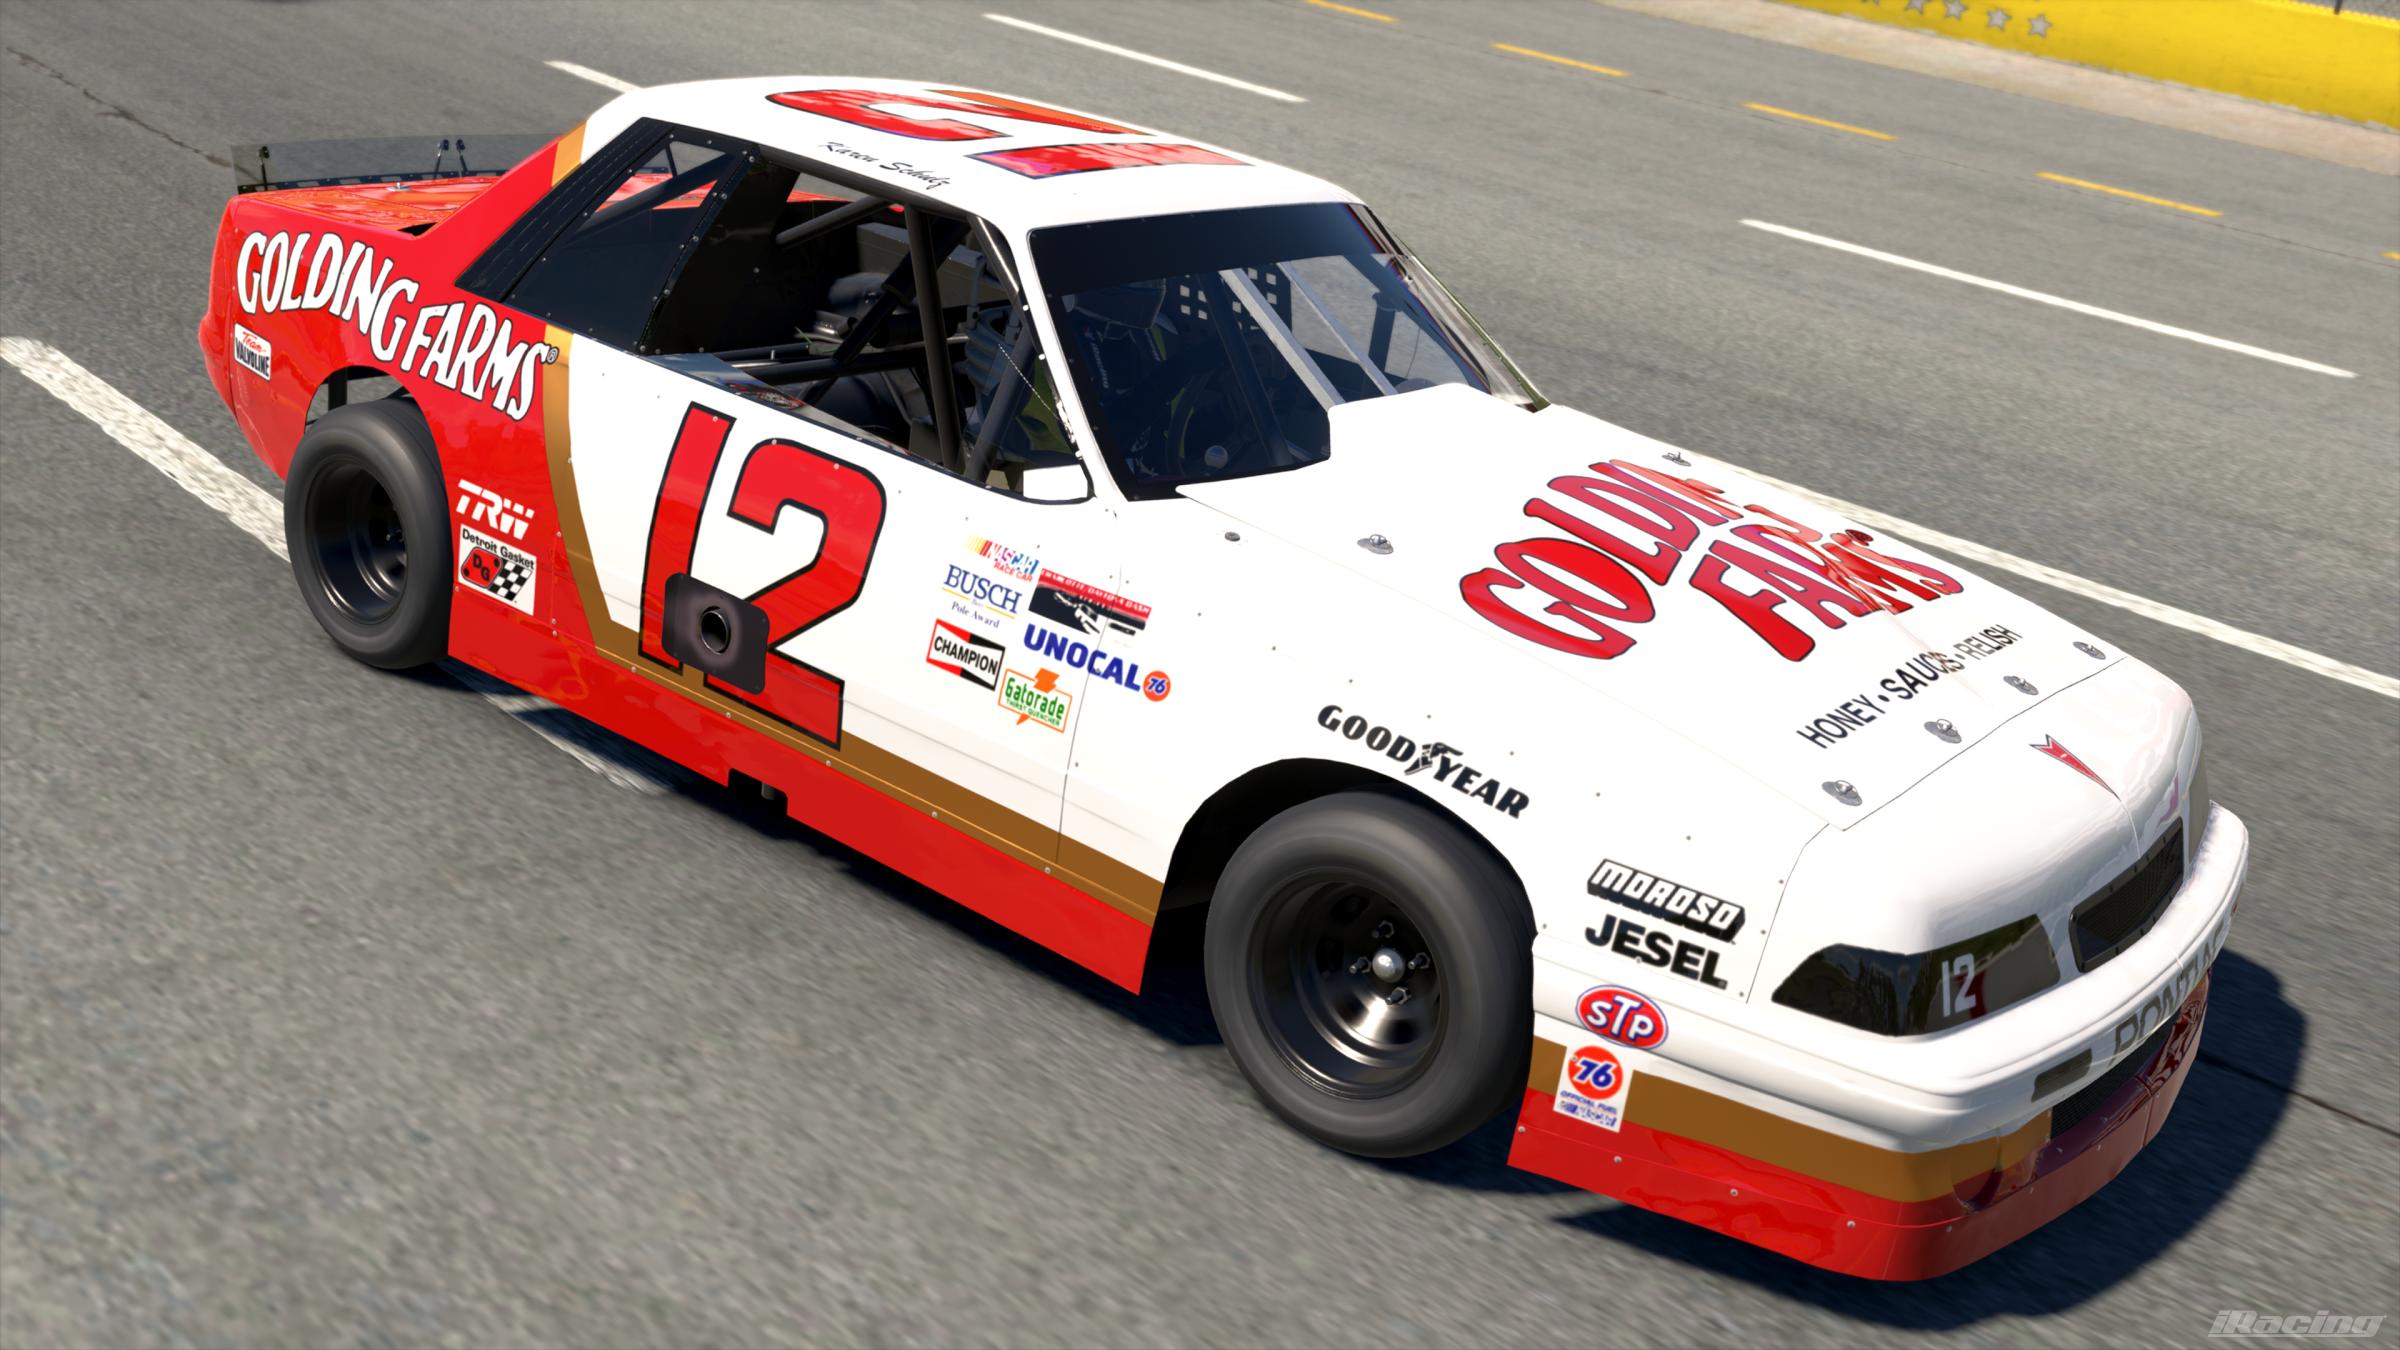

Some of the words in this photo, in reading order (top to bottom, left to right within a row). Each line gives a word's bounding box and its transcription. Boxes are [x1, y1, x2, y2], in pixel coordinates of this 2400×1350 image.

[819, 141, 878, 162] Karen
[879, 161, 950, 190] Schulz
[236, 230, 420, 361] GOLDING
[235, 336, 270, 378] VALVOLINE
[242, 331, 267, 353] Team
[456, 479, 535, 541] TRW
[462, 527, 498, 554] Detroit
[500, 545, 535, 570] Gasket
[993, 562, 1014, 577] RACE
[1015, 570, 1033, 583] CAR
[638, 401, 887, 752] 12
[944, 564, 1023, 614] BUSCH
[952, 601, 970, 616] Pole
[971, 610, 1000, 628] Award
[934, 636, 998, 676] CHAMPION
[1024, 623, 1142, 693] UNOCAL
[1148, 676, 1167, 695] 76
[1005, 677, 1065, 720] Gatorade
[1796, 694, 1886, 749] HONEY
[1953, 624, 2023, 660] RELISH
[1317, 704, 1530, 819] GOODYEAR
[1588, 858, 1746, 941] MOROSO
[1585, 913, 1728, 991] JESEL
[1942, 953, 1977, 1018] 12
[1585, 994, 1656, 1041] STP
[1573, 1056, 1618, 1090] 76
